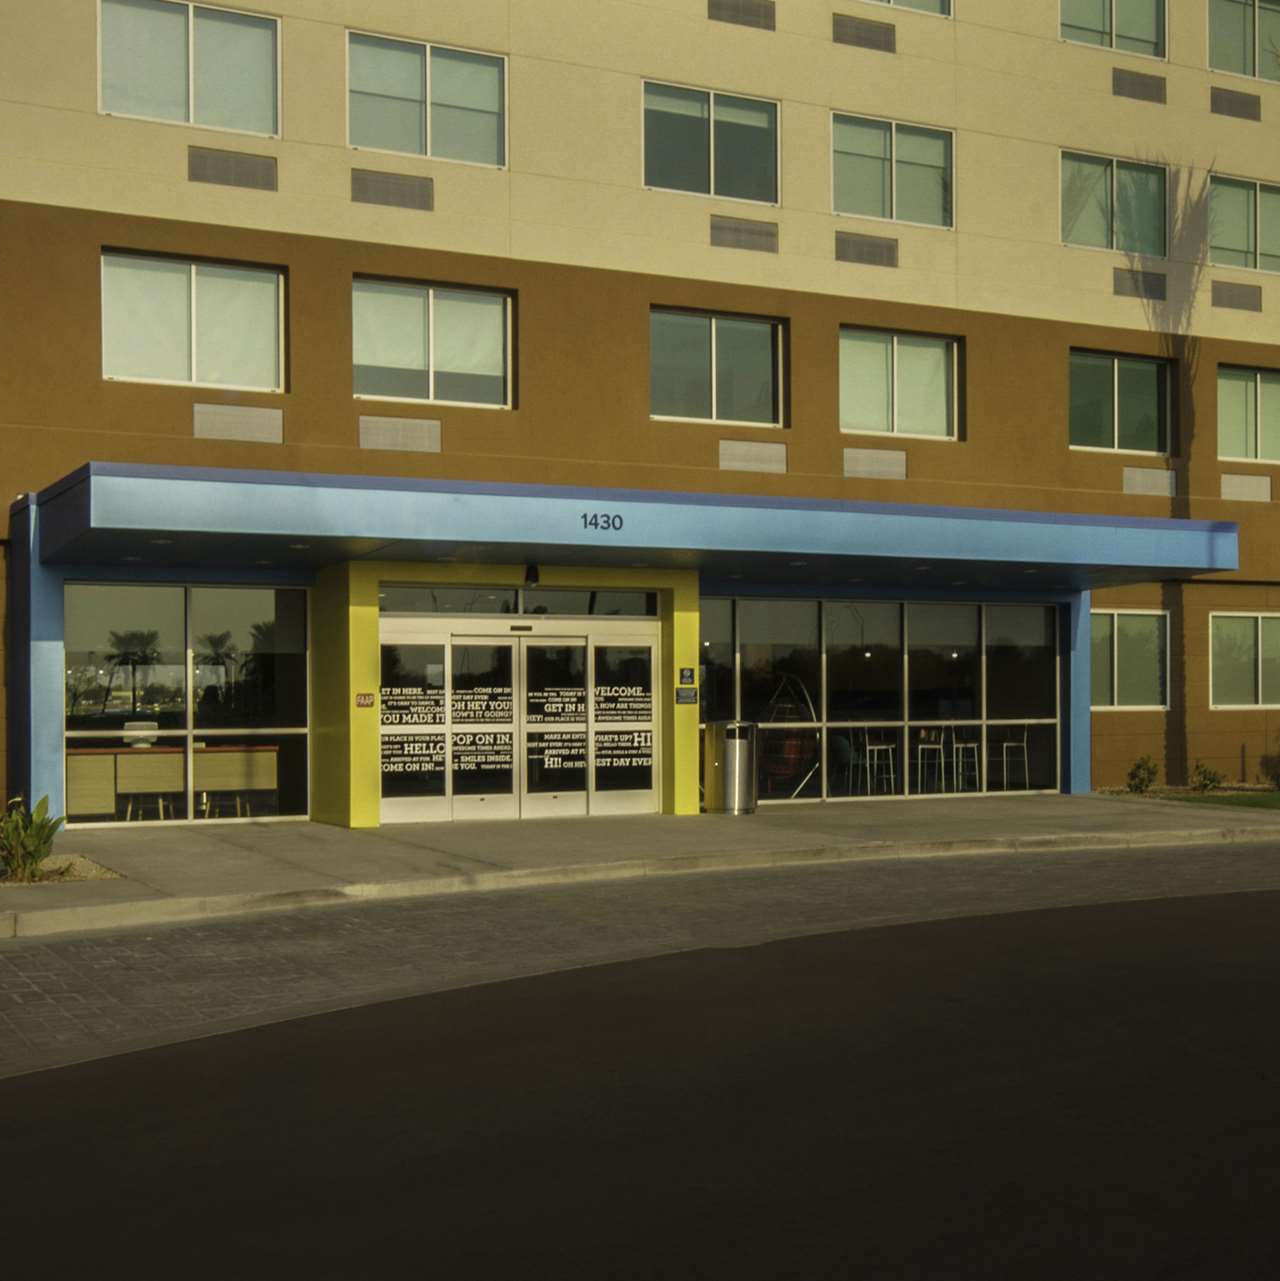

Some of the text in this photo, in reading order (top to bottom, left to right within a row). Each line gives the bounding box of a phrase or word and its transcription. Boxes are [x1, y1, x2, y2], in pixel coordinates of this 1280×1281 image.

[581, 513, 623, 530] 1430
[467, 701, 487, 710] HEY
[544, 703, 564, 712] GET
[565, 703, 576, 712] IN
[402, 714, 434, 723] MADE
[475, 734, 494, 745] ON
[496, 734, 512, 745] IN.
[403, 742, 445, 754] HELLO
[544, 757, 562, 768] HI!
[613, 758, 631, 766] DAY
[405, 763, 420, 771] ON
